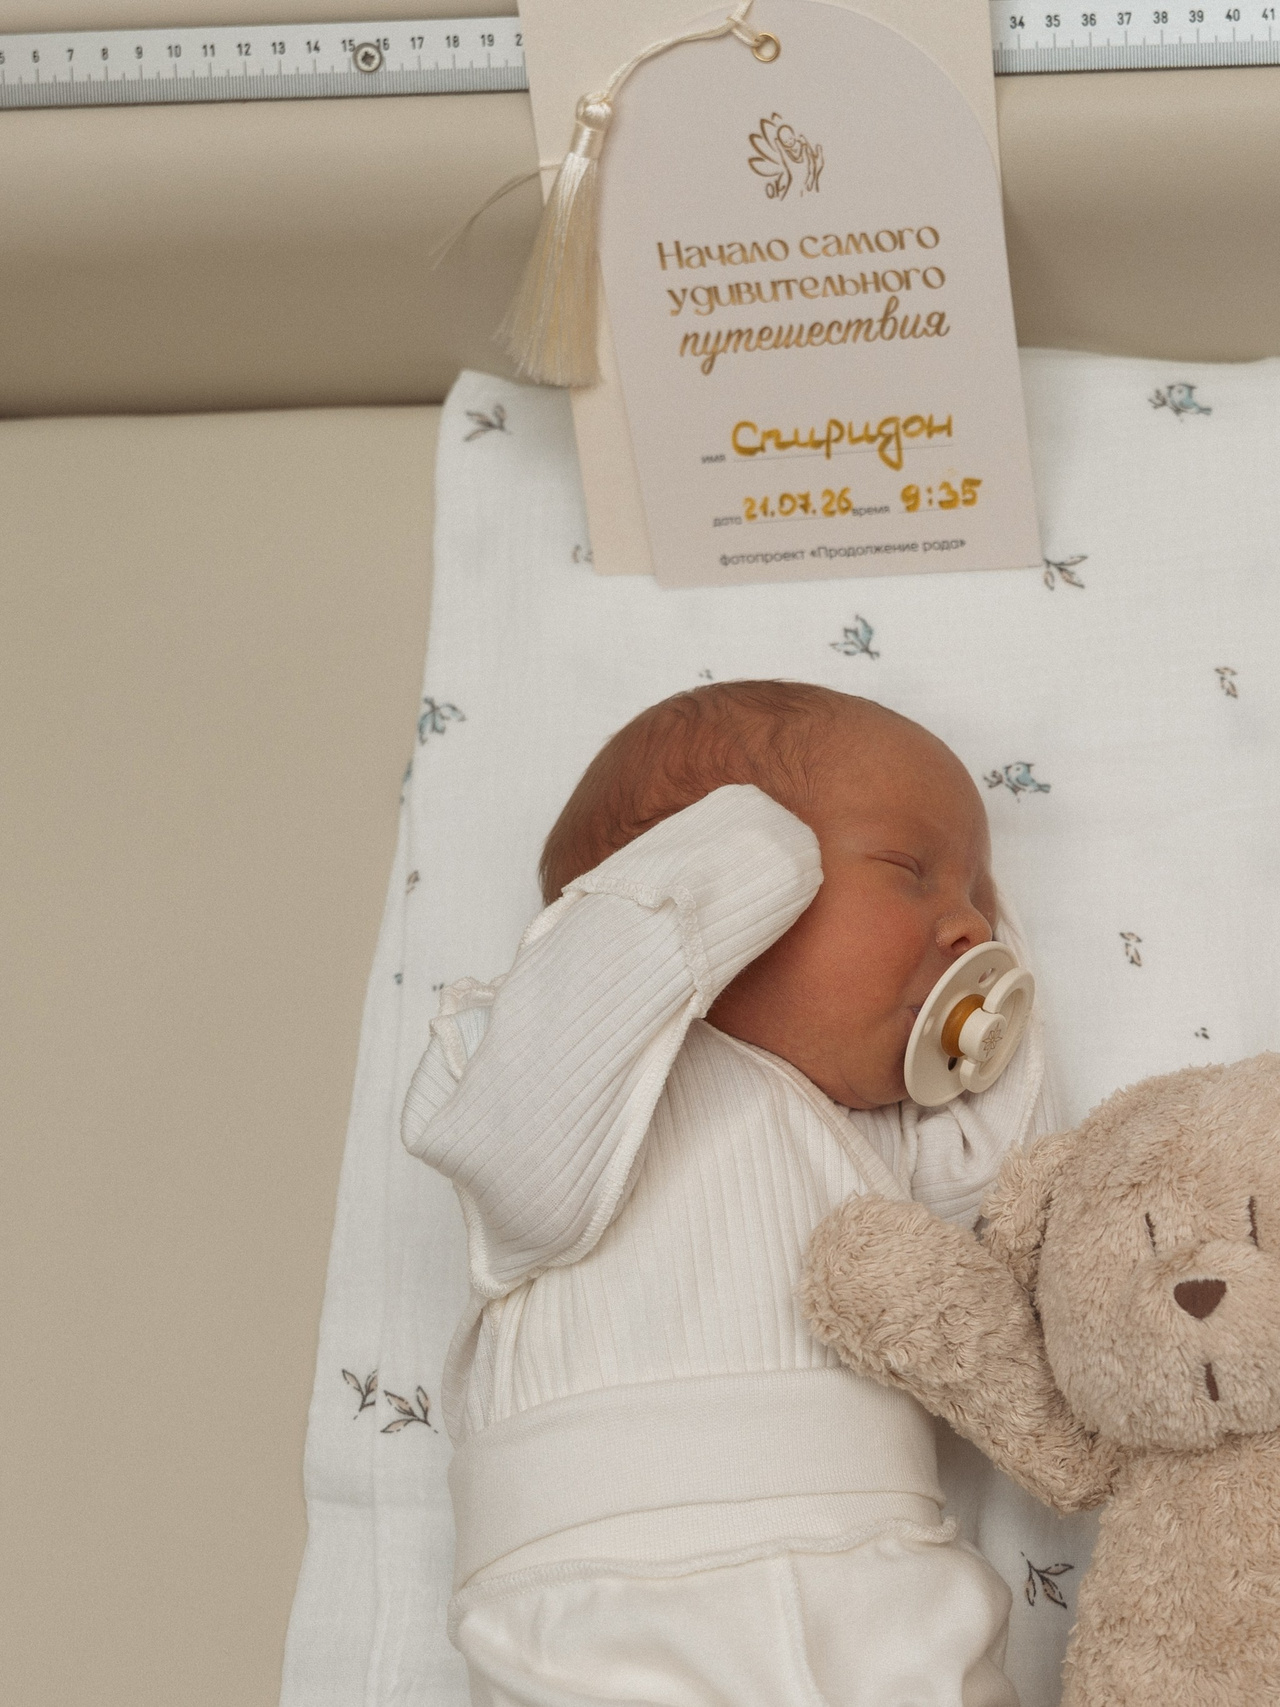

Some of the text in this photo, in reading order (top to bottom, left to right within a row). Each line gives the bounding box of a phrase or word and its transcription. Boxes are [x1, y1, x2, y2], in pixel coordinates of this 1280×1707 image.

[1010, 16, 1024, 29] 34
[1046, 14, 1060, 28] 35
[1082, 13, 1096, 26] 36
[1117, 12, 1132, 25] 37
[1154, 11, 1168, 24] 38
[1189, 10, 1204, 23] 39
[1226, 9, 1240, 21] 40
[1262, 8, 1275, 20] 41
[32, 50, 40, 63] 6
[67, 48, 74, 61] 7
[101, 48, 108, 60] 8
[135, 46, 143, 59] 9
[167, 45, 181, 58] 10
[202, 44, 215, 56] 11
[237, 43, 251, 56] 12
[271, 41, 285, 54] 13
[306, 41, 320, 52] 14
[341, 39, 355, 52] 15
[376, 38, 390, 51] 16
[410, 36, 424, 49] 17
[446, 35, 459, 48] 18
[481, 34, 494, 47] 19
[656, 226, 940, 271] Начало самого
[667, 266, 946, 317] удивительного
[679, 295, 951, 376] путешествия
[731, 414, 954, 471] Спиридон
[701, 454, 727, 464] имя
[852, 505, 891, 517] время
[901, 477, 983, 513] 9:35
[719, 539, 966, 567] фотопроект «Продолжение рода»
